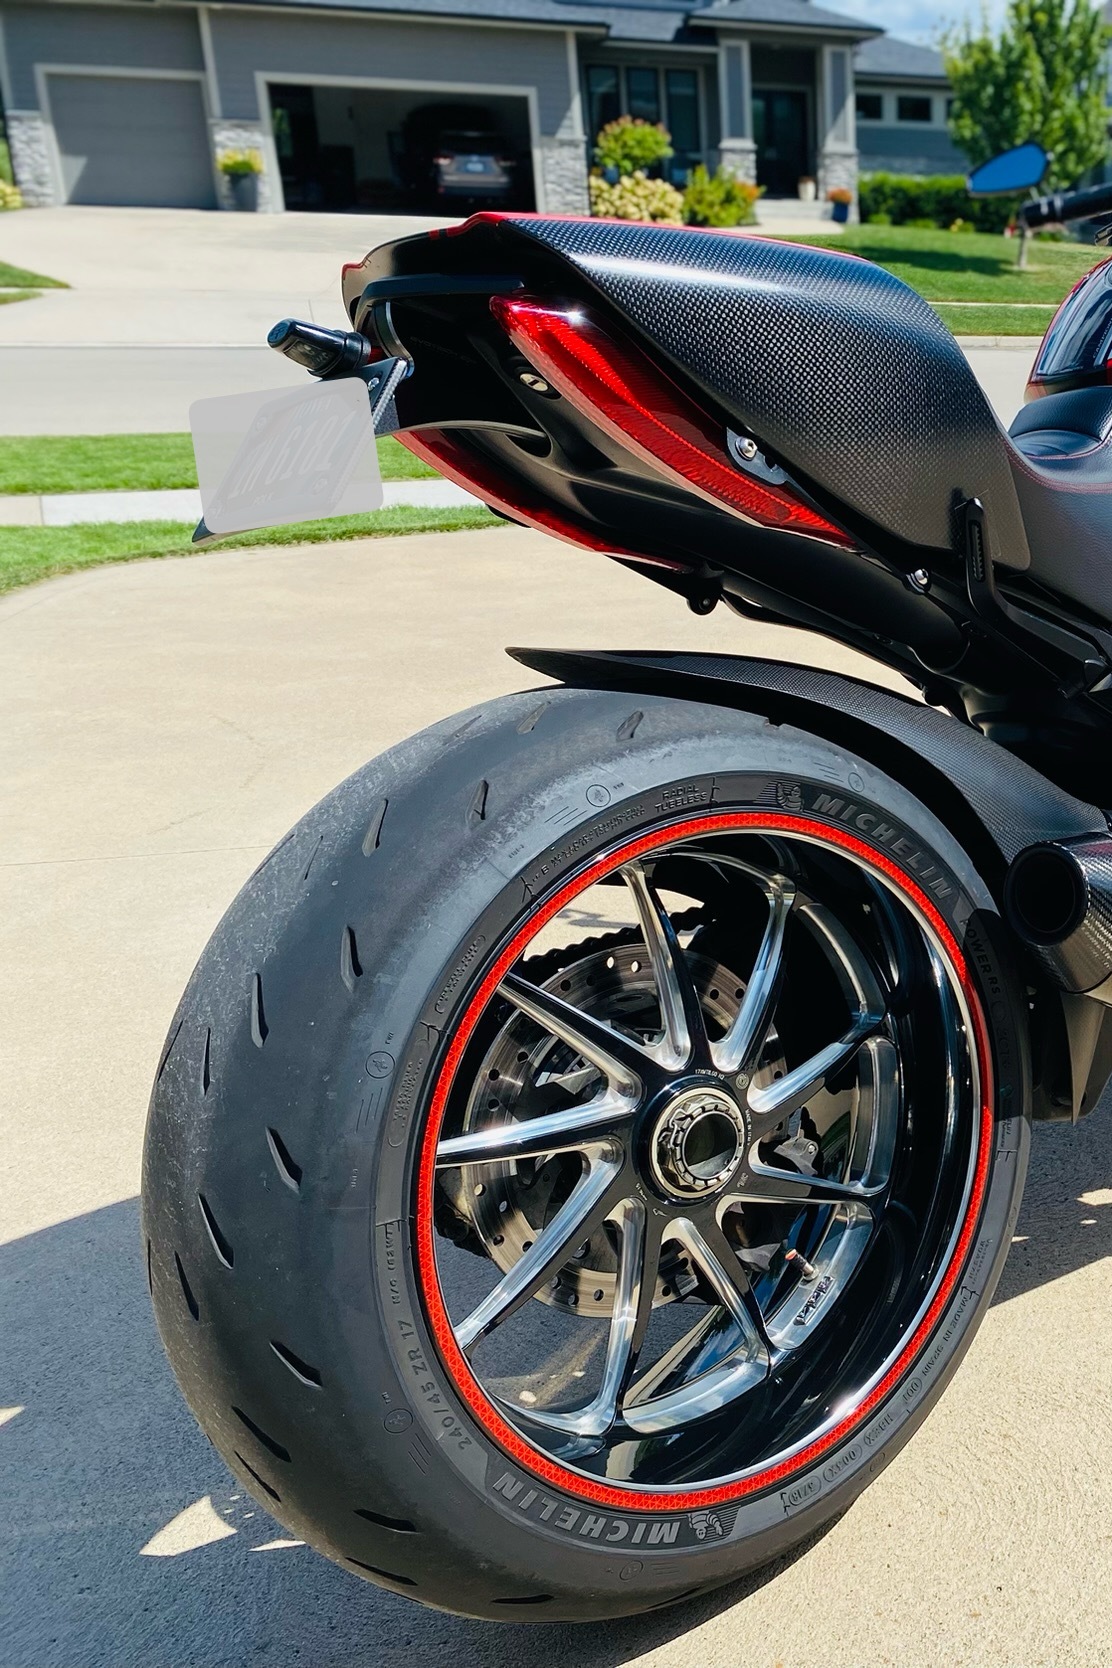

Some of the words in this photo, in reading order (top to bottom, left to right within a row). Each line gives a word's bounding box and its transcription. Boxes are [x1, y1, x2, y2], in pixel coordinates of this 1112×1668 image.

[655, 791, 708, 814] TUBELESS
[662, 784, 700, 801] RADIAL
[811, 793, 953, 899] MICHELIN
[960, 917, 993, 975] POWER
[988, 976, 1002, 996] RS
[951, 1294, 969, 1328] MADE
[397, 1319, 415, 1340] 17
[942, 1329, 953, 1343] IN
[407, 1347, 428, 1375] ZR
[421, 1381, 473, 1450] 240/45
[492, 1472, 681, 1544] MICHELIN
